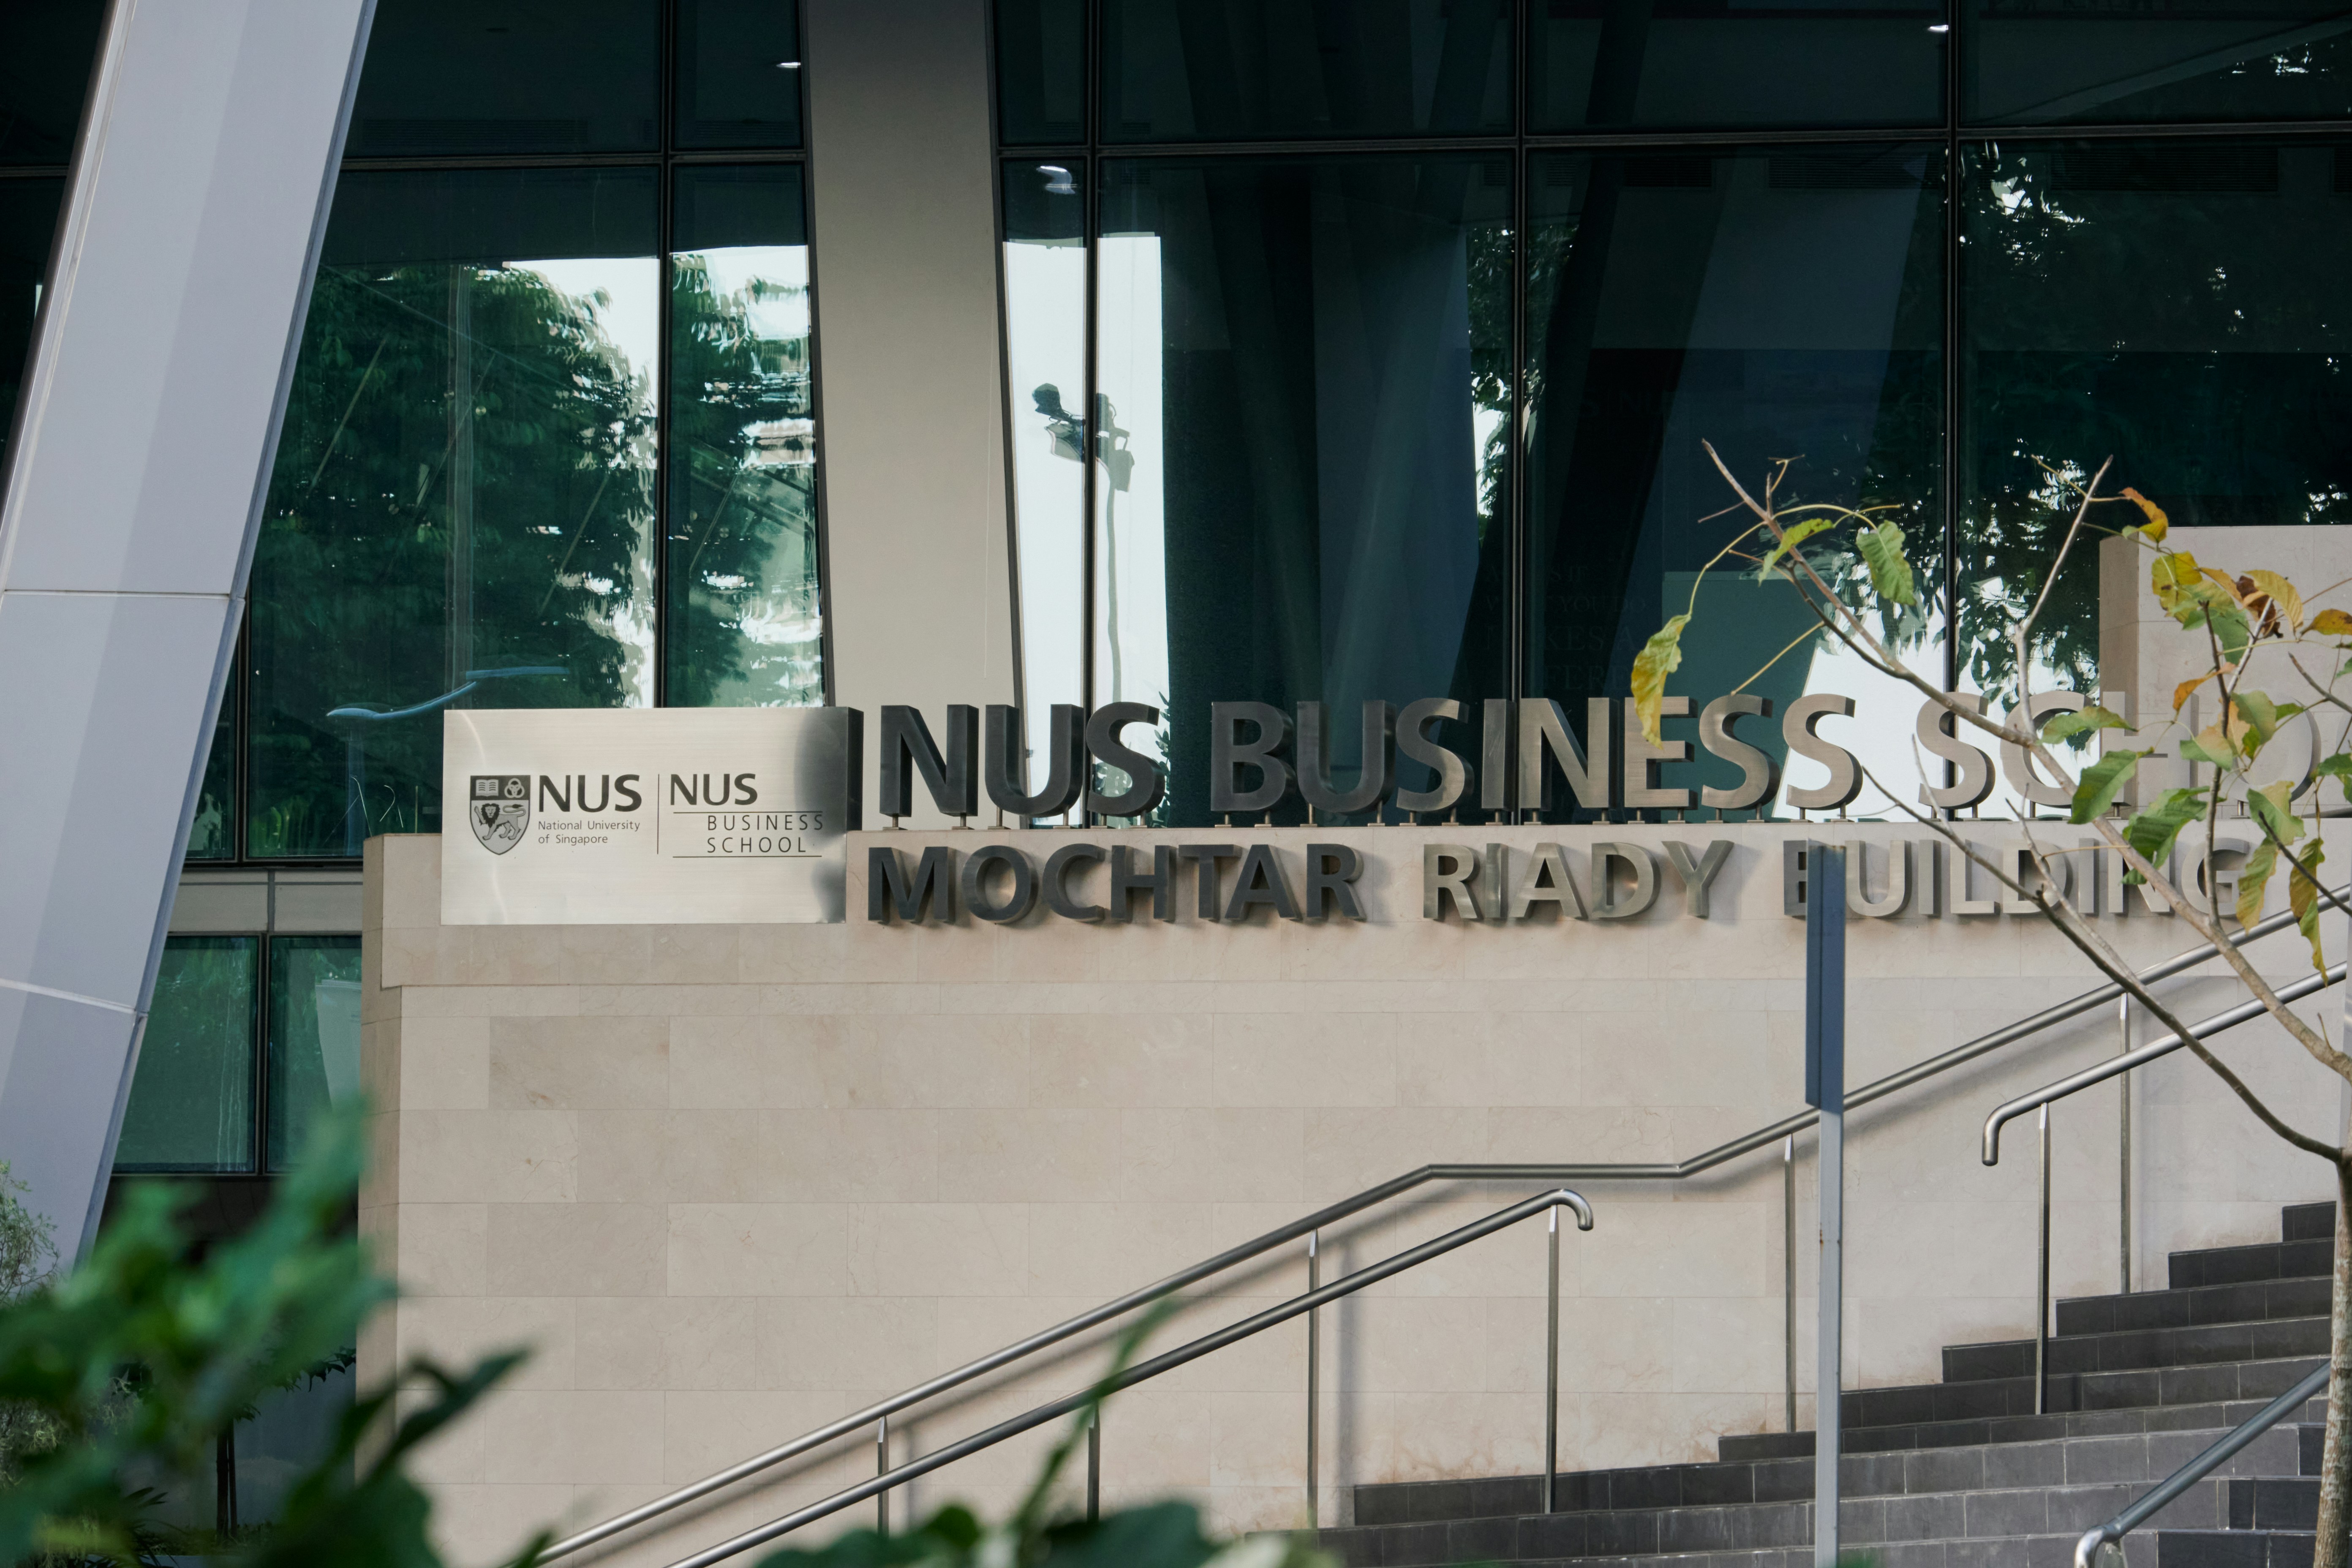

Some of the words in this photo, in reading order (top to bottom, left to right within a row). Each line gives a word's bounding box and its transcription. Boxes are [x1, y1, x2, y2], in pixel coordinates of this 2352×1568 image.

[879, 701, 1166, 817] NUS
[1211, 693, 1862, 814] BUSINESS
[1916, 689, 2352, 809] SCHO
[539, 774, 642, 812] NUS
[670, 773, 758, 806] NUS
[538, 820, 582, 830] National
[588, 820, 640, 832] University
[708, 814, 824, 831] BUSINESS
[538, 834, 550, 844] of
[556, 834, 608, 846] Singapore
[707, 837, 806, 853] SCHOOL
[868, 844, 1364, 923] MOCHTAR
[1423, 840, 1734, 920] RIADY
